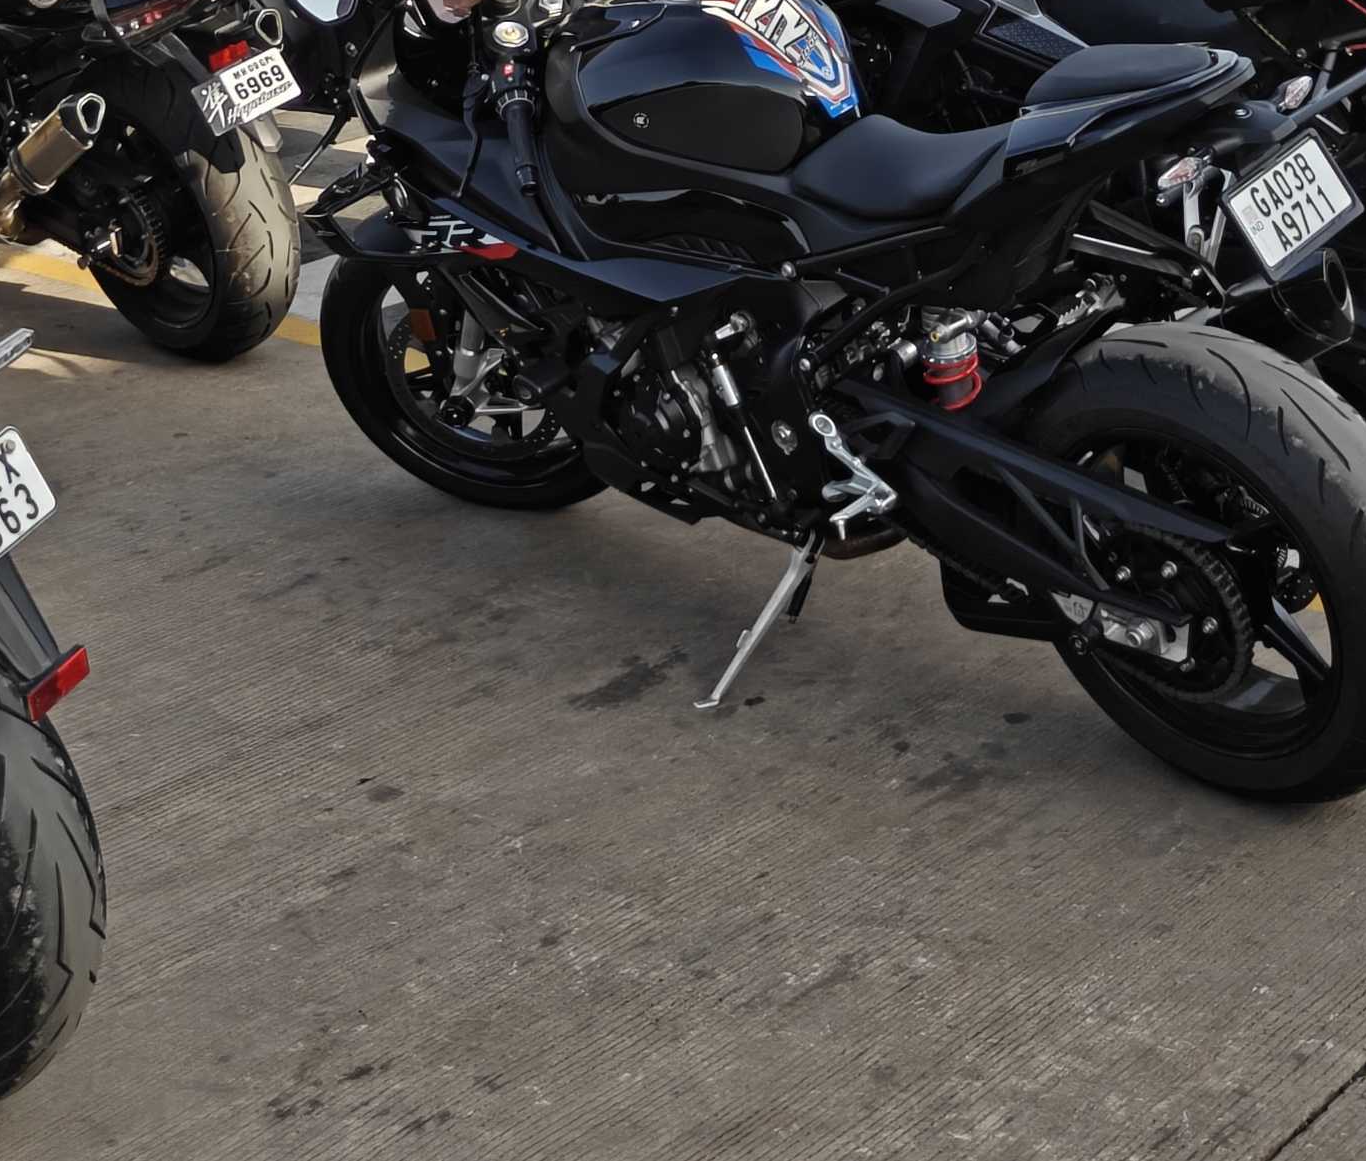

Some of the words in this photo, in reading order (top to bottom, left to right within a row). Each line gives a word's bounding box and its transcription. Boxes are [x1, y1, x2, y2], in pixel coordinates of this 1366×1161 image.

[234, 64, 285, 100] 6969
[1250, 153, 1316, 217] GA03B
[1272, 185, 1335, 252] A9711
